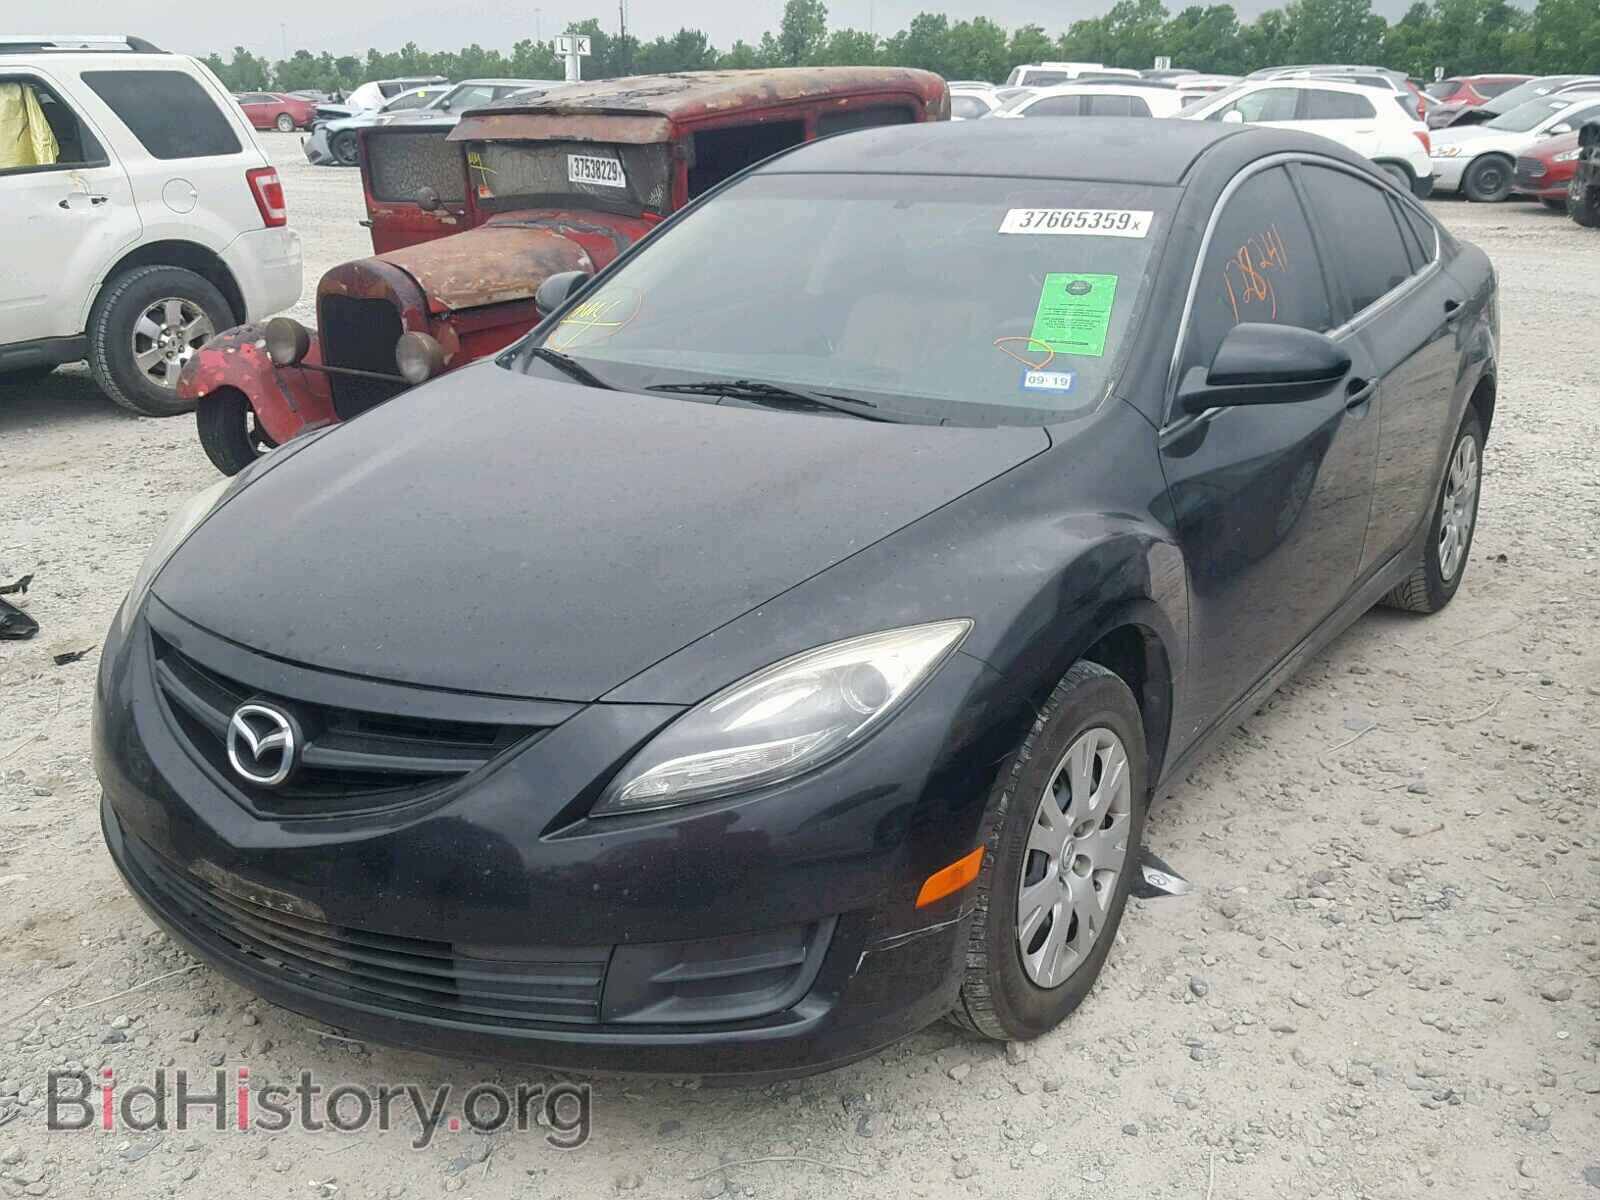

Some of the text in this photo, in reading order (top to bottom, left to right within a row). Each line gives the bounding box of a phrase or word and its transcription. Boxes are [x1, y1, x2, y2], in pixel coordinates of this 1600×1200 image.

[560, 39, 568, 52] L
[577, 39, 586, 52] K
[574, 157, 618, 182] 37538229
